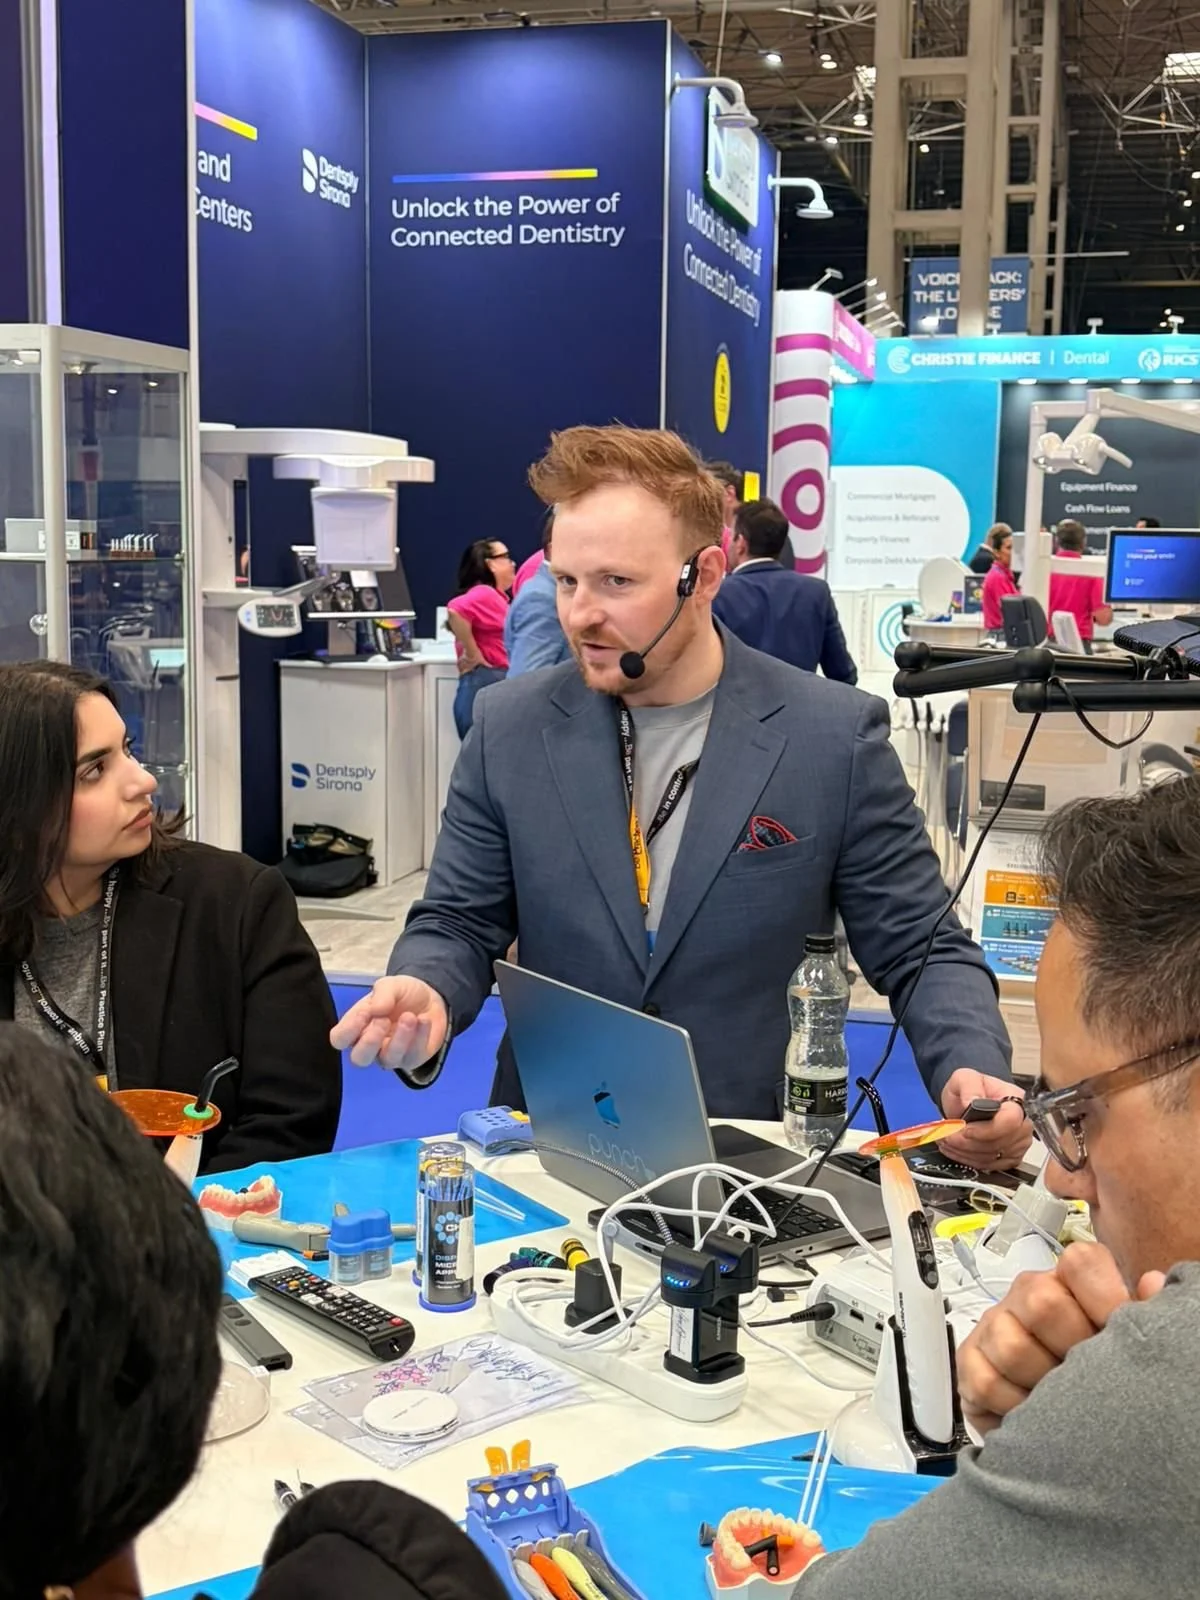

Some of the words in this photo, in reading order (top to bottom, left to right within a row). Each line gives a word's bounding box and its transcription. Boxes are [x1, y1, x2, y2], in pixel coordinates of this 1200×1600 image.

[197, 150, 231, 183] and
[320, 156, 359, 193] Dentsply
[320, 178, 351, 208] Sirona
[391, 196, 469, 219] Unlock
[474, 196, 512, 217] the
[518, 195, 591, 216] Power
[596, 192, 621, 213] of
[391, 224, 513, 247] Connected
[519, 222, 626, 247] Dentistry
[913, 290, 945, 303] THE
[911, 351, 976, 366] CHRISTIE
[978, 351, 1041, 366] FINANCE
[1064, 349, 1110, 365] Dental
[1060, 482, 1105, 493] Equipment
[1105, 482, 1138, 492] Finance
[1106, 504, 1131, 514] Loans
[316, 763, 377, 781] Dentsply
[316, 777, 363, 792] Sirona
[97, 990, 107, 1029] Practice
[96, 1030, 105, 1052] Plan
